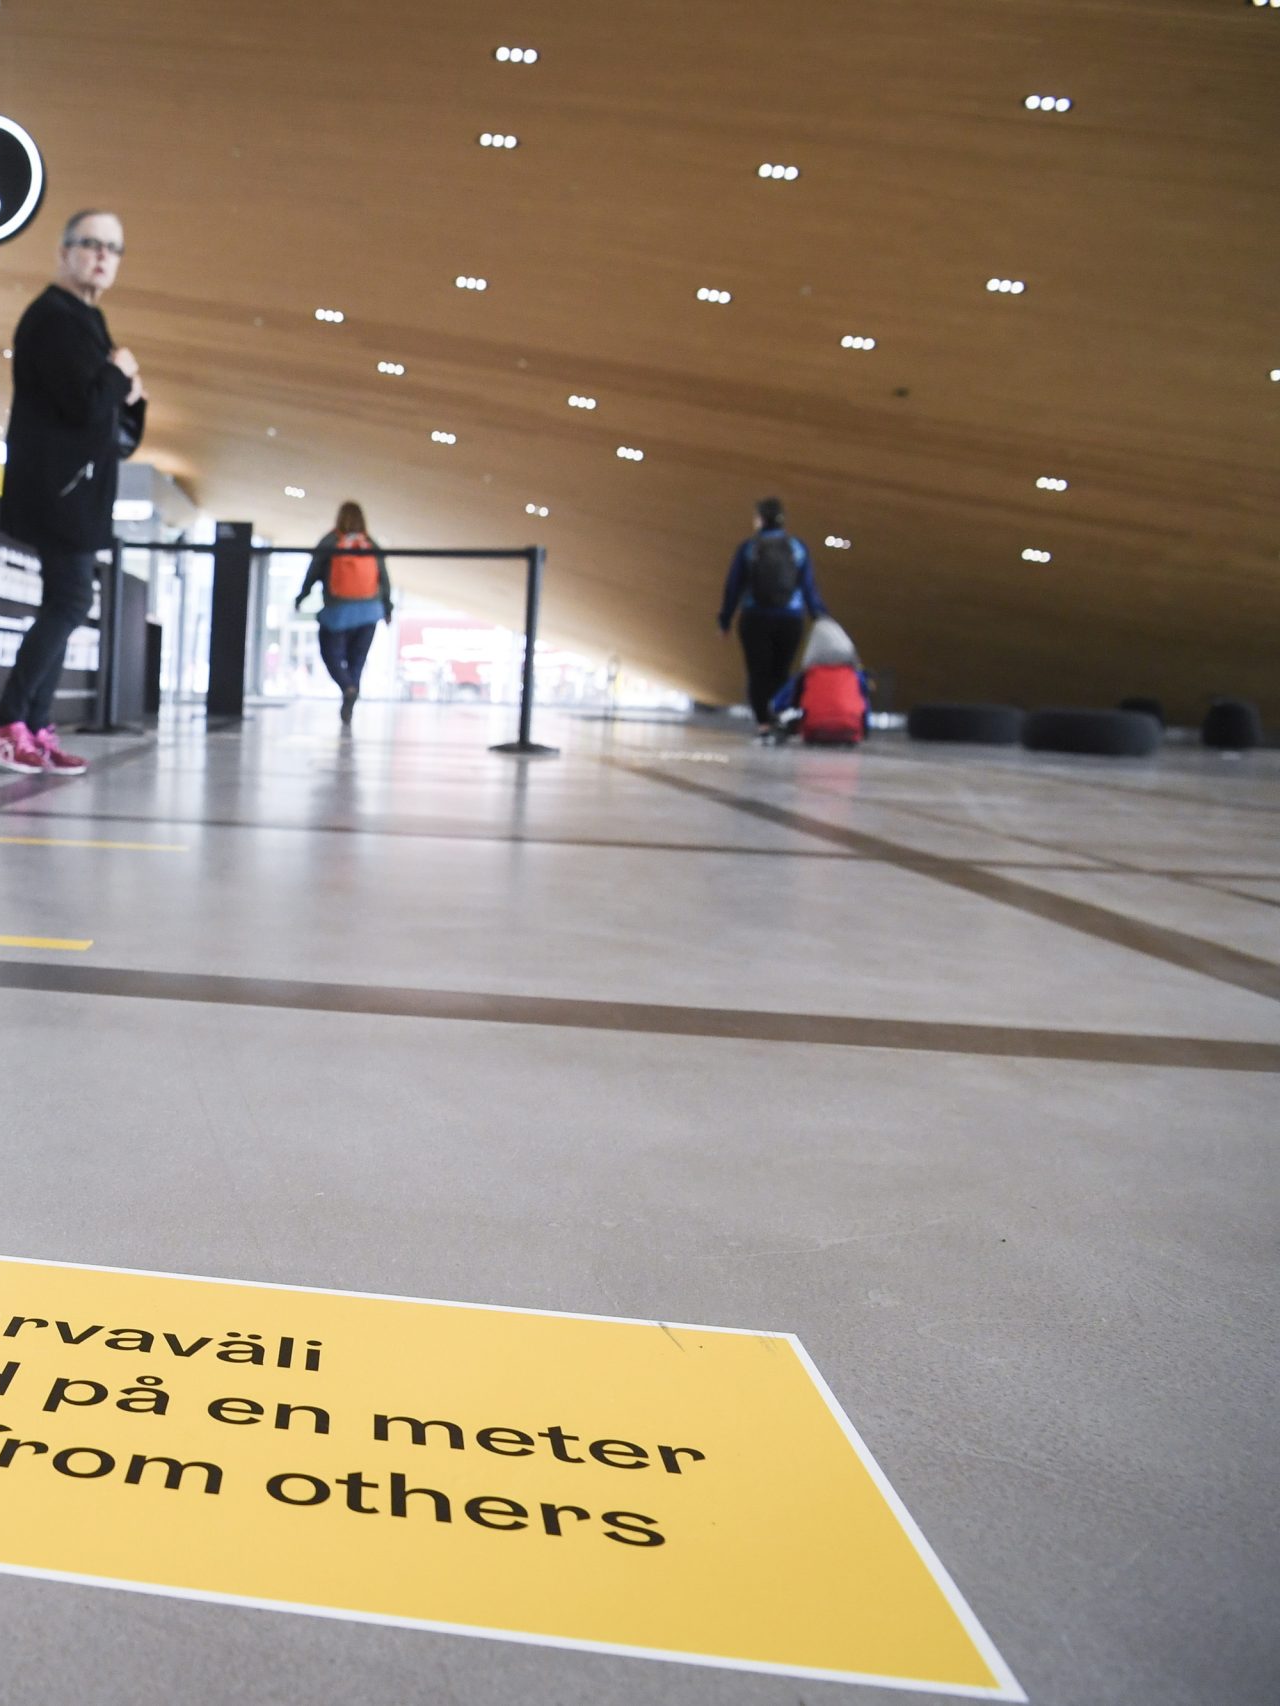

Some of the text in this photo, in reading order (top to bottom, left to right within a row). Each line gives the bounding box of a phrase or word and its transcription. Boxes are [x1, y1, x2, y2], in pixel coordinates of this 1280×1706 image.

[41, 1374, 170, 1416] på
[206, 1396, 331, 1435] en
[372, 1412, 707, 1476] meter
[264, 1470, 667, 1548] others
